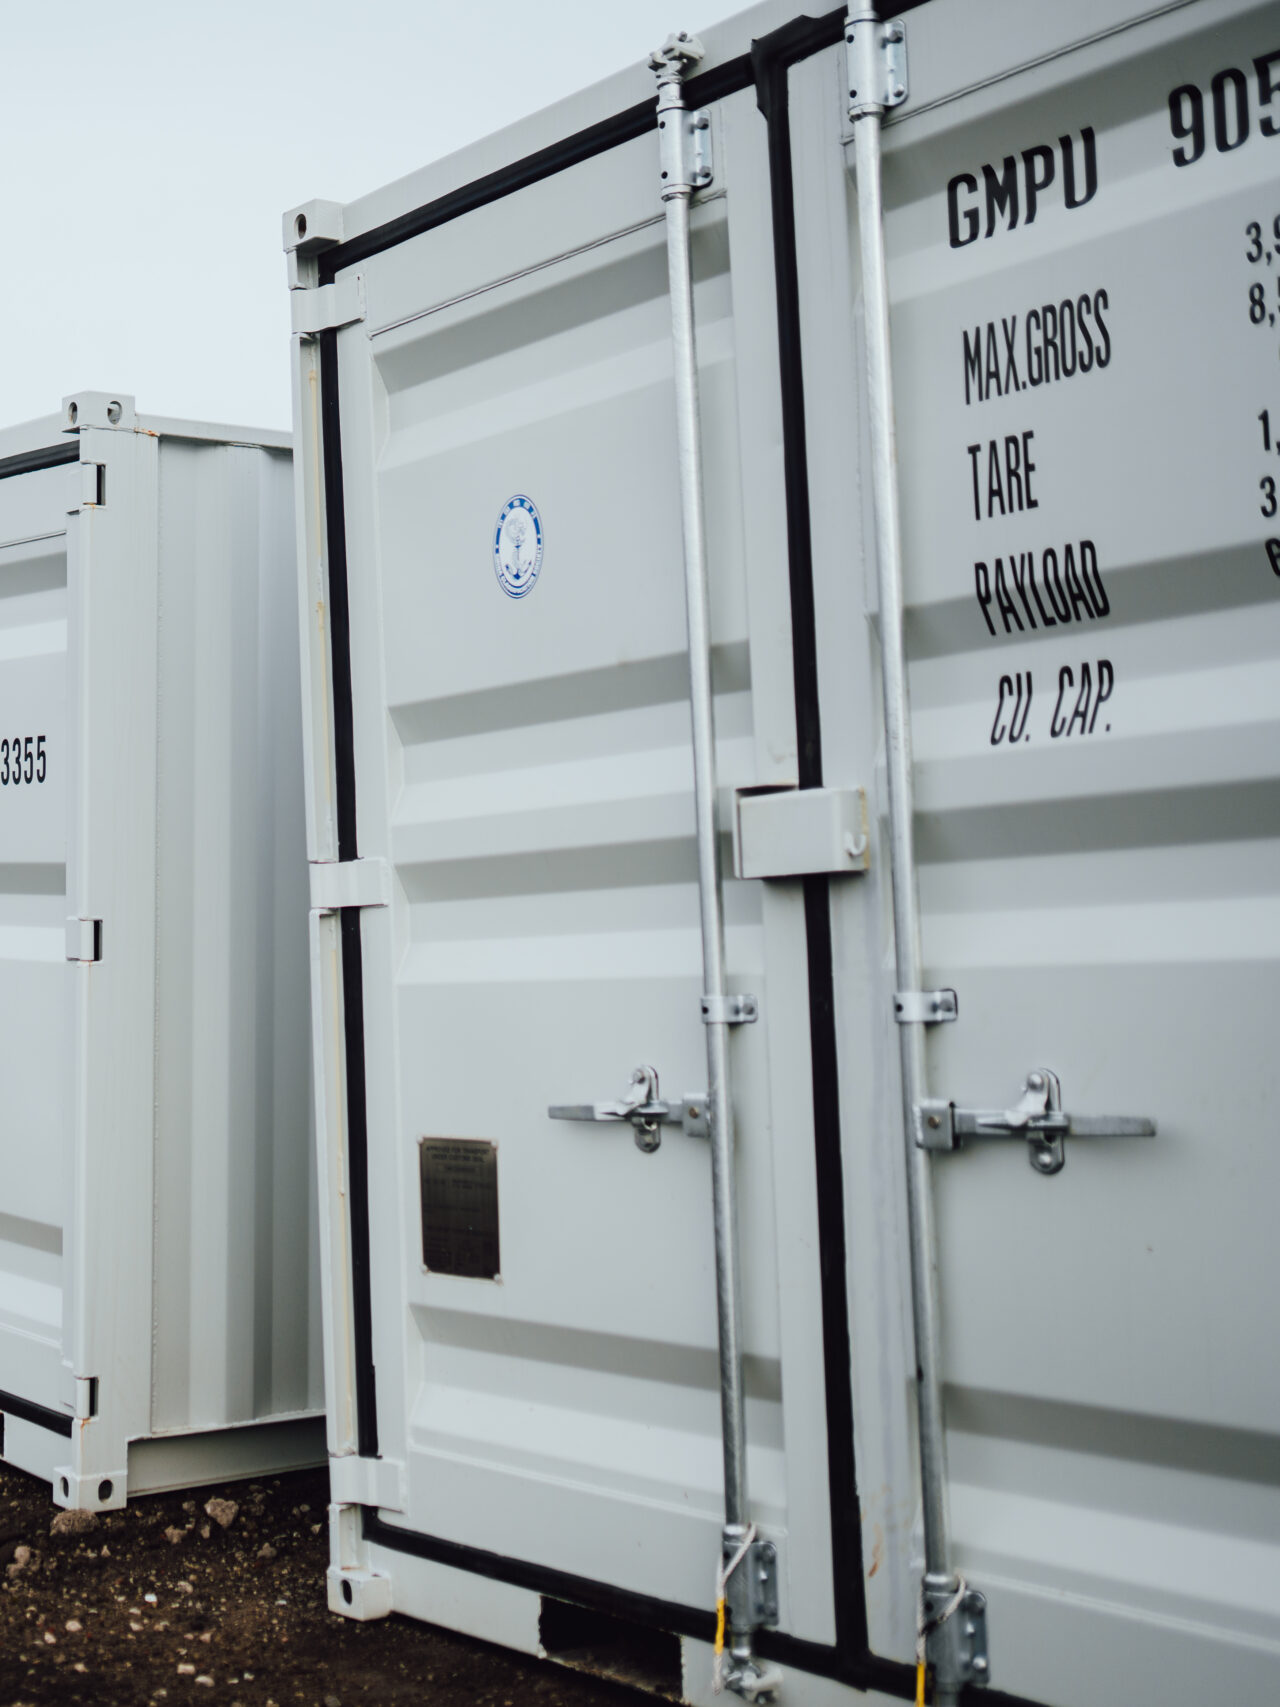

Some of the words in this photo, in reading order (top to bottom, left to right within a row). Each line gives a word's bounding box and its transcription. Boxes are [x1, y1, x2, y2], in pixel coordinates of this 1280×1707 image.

[946, 126, 1098, 249] GMPU
[962, 288, 1111, 406] MAX.GROSS
[1249, 276, 1280, 328] 8,
[967, 430, 1039, 521] TARE
[974, 539, 1111, 636] PAYLOAD
[990, 671, 1033, 746] CU.
[1050, 659, 1114, 738] CAP.
